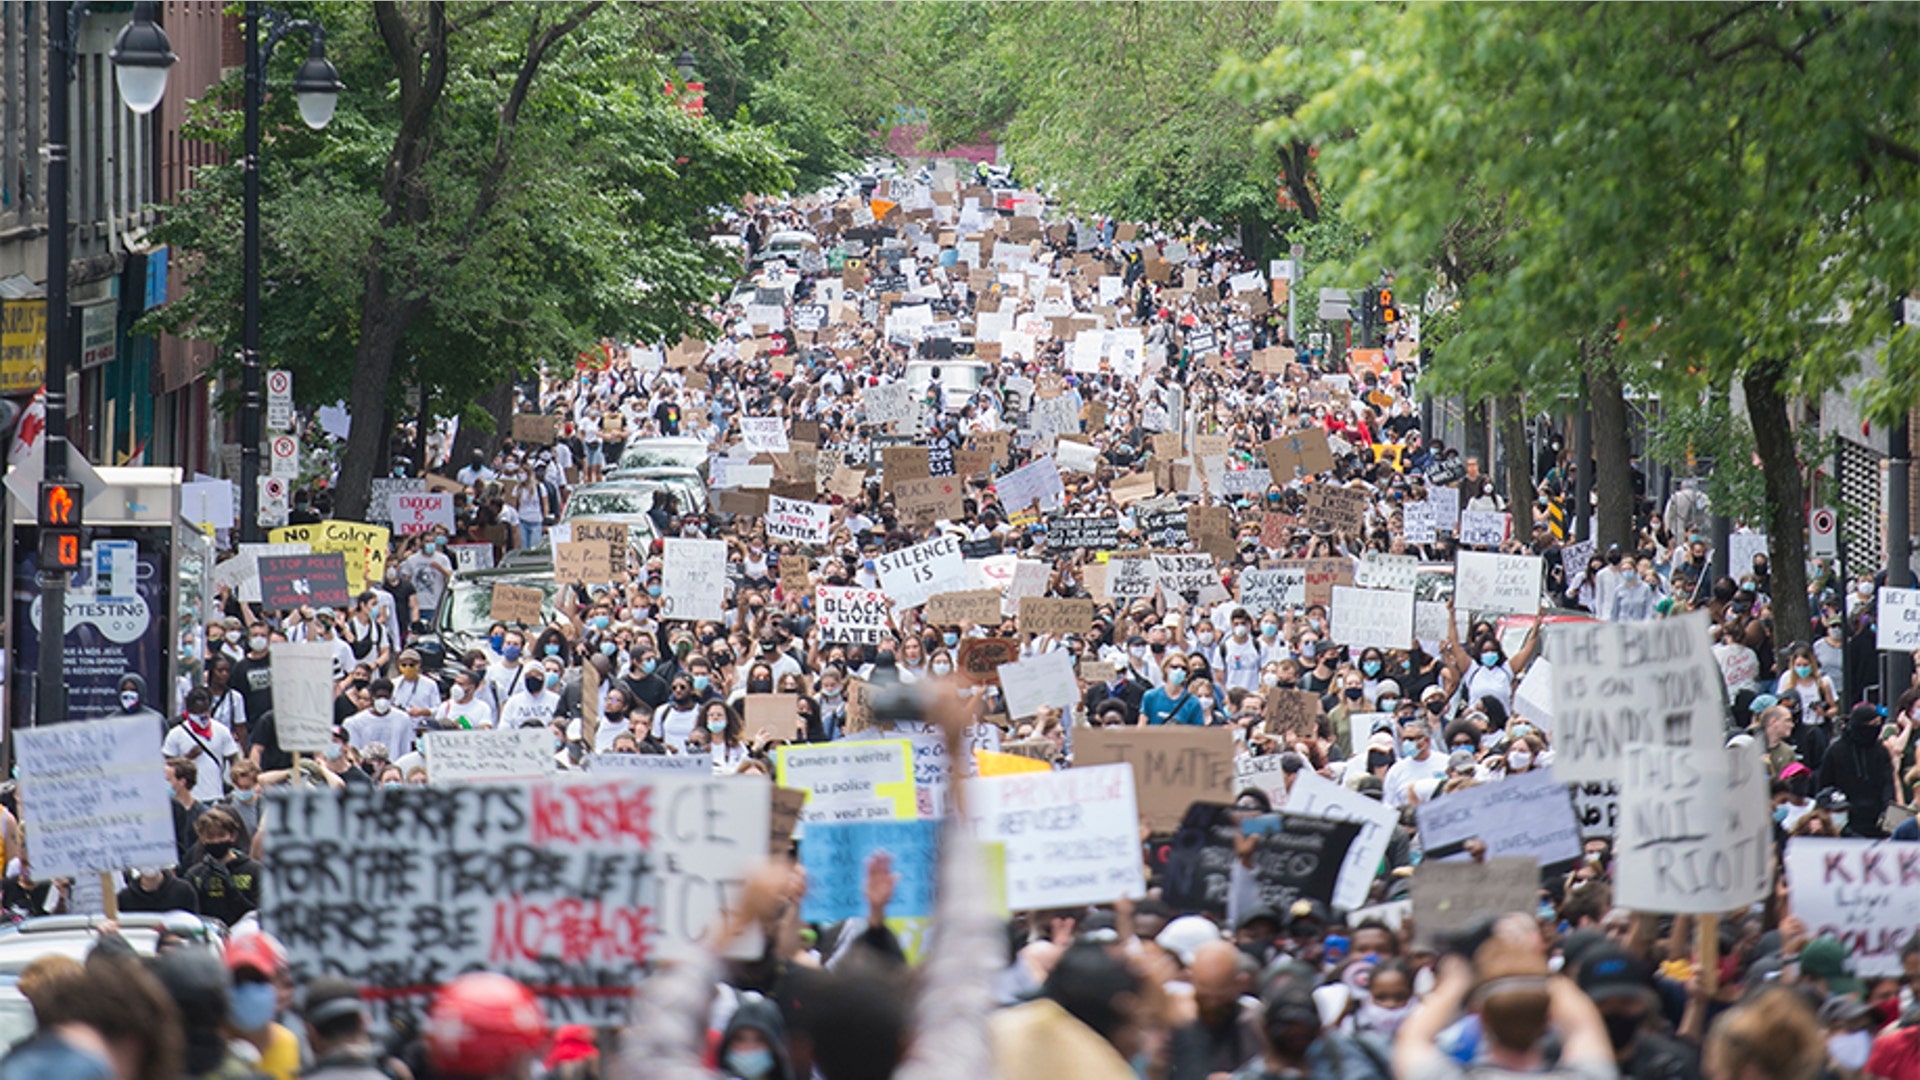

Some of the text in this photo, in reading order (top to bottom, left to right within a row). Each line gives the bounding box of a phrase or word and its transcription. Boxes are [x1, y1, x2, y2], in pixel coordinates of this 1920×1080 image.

[896, 482, 932, 497] BLACK
[399, 496, 442, 511] ENOUGH
[773, 499, 815, 516] BLACK
[413, 509, 424, 521] IS
[284, 528, 310, 542] NO
[326, 525, 377, 544] Color
[576, 525, 625, 542] BLACK
[1463, 530, 1502, 545] FILMED
[58, 535, 78, 565] 0
[371, 549, 382, 563] A
[880, 538, 956, 574] SILENCE
[269, 557, 343, 572] STOP POLICE
[1153, 556, 1174, 573] NO
[912, 564, 934, 583] IS
[1157, 576, 1177, 592] NO
[824, 598, 886, 615] BLACK
[1024, 602, 1048, 614] NO
[838, 614, 879, 626] LIVES
[1022, 616, 1049, 629] NO
[1554, 620, 1695, 668] THE BLOOD
[1564, 676, 1588, 698] IS
[1600, 676, 1634, 697] ON
[1654, 665, 1712, 709] YOUR
[519, 706, 553, 717] NASA
[1561, 706, 1654, 762] HANDS
[1628, 748, 1702, 791] THIS
[814, 780, 872, 795] La police
[265, 788, 322, 838] IF
[835, 807, 863, 820] veut
[867, 807, 890, 819] pas
[1632, 796, 1695, 838] NOT
[1653, 828, 1770, 896] RIOT!
[409, 907, 480, 951] BE
[490, 895, 547, 963] NO
